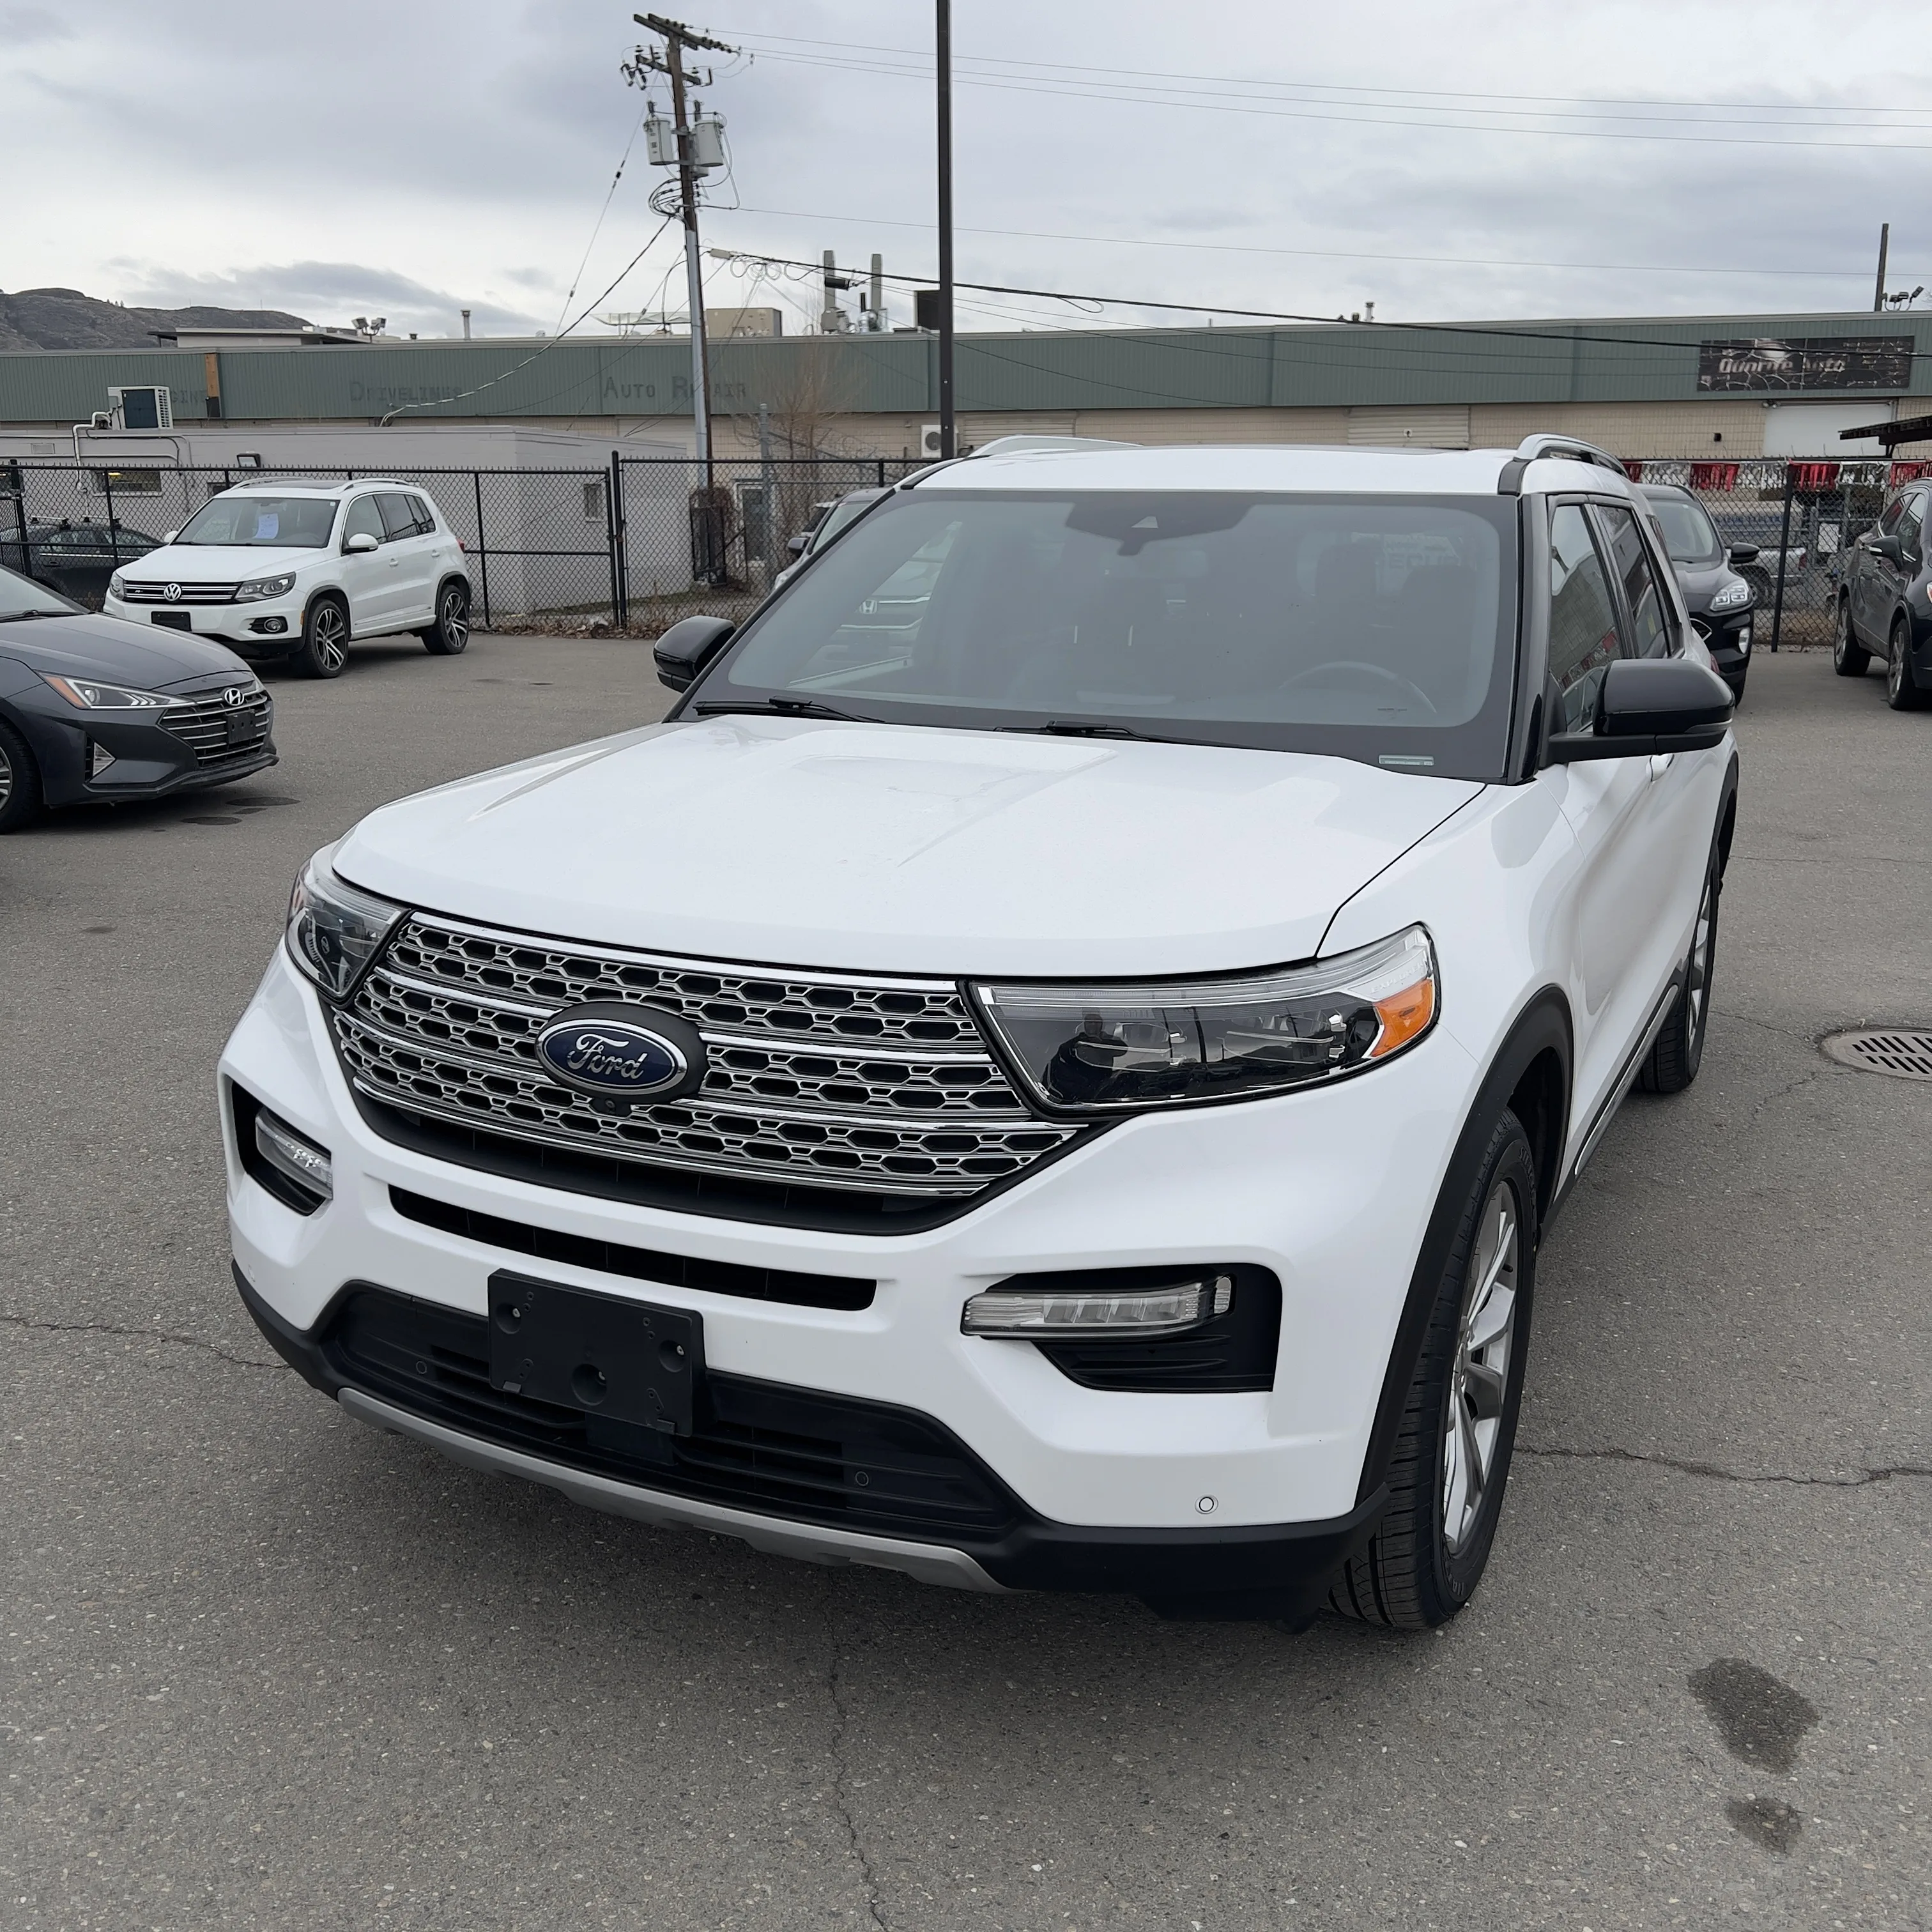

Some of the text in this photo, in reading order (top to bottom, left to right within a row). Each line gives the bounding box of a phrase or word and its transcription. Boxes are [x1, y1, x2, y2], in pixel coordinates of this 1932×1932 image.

[603, 376, 747, 399] AUTO RAIR
[1370, 962, 1424, 993] EXPLORER
[567, 1033, 648, 1080] Ford
